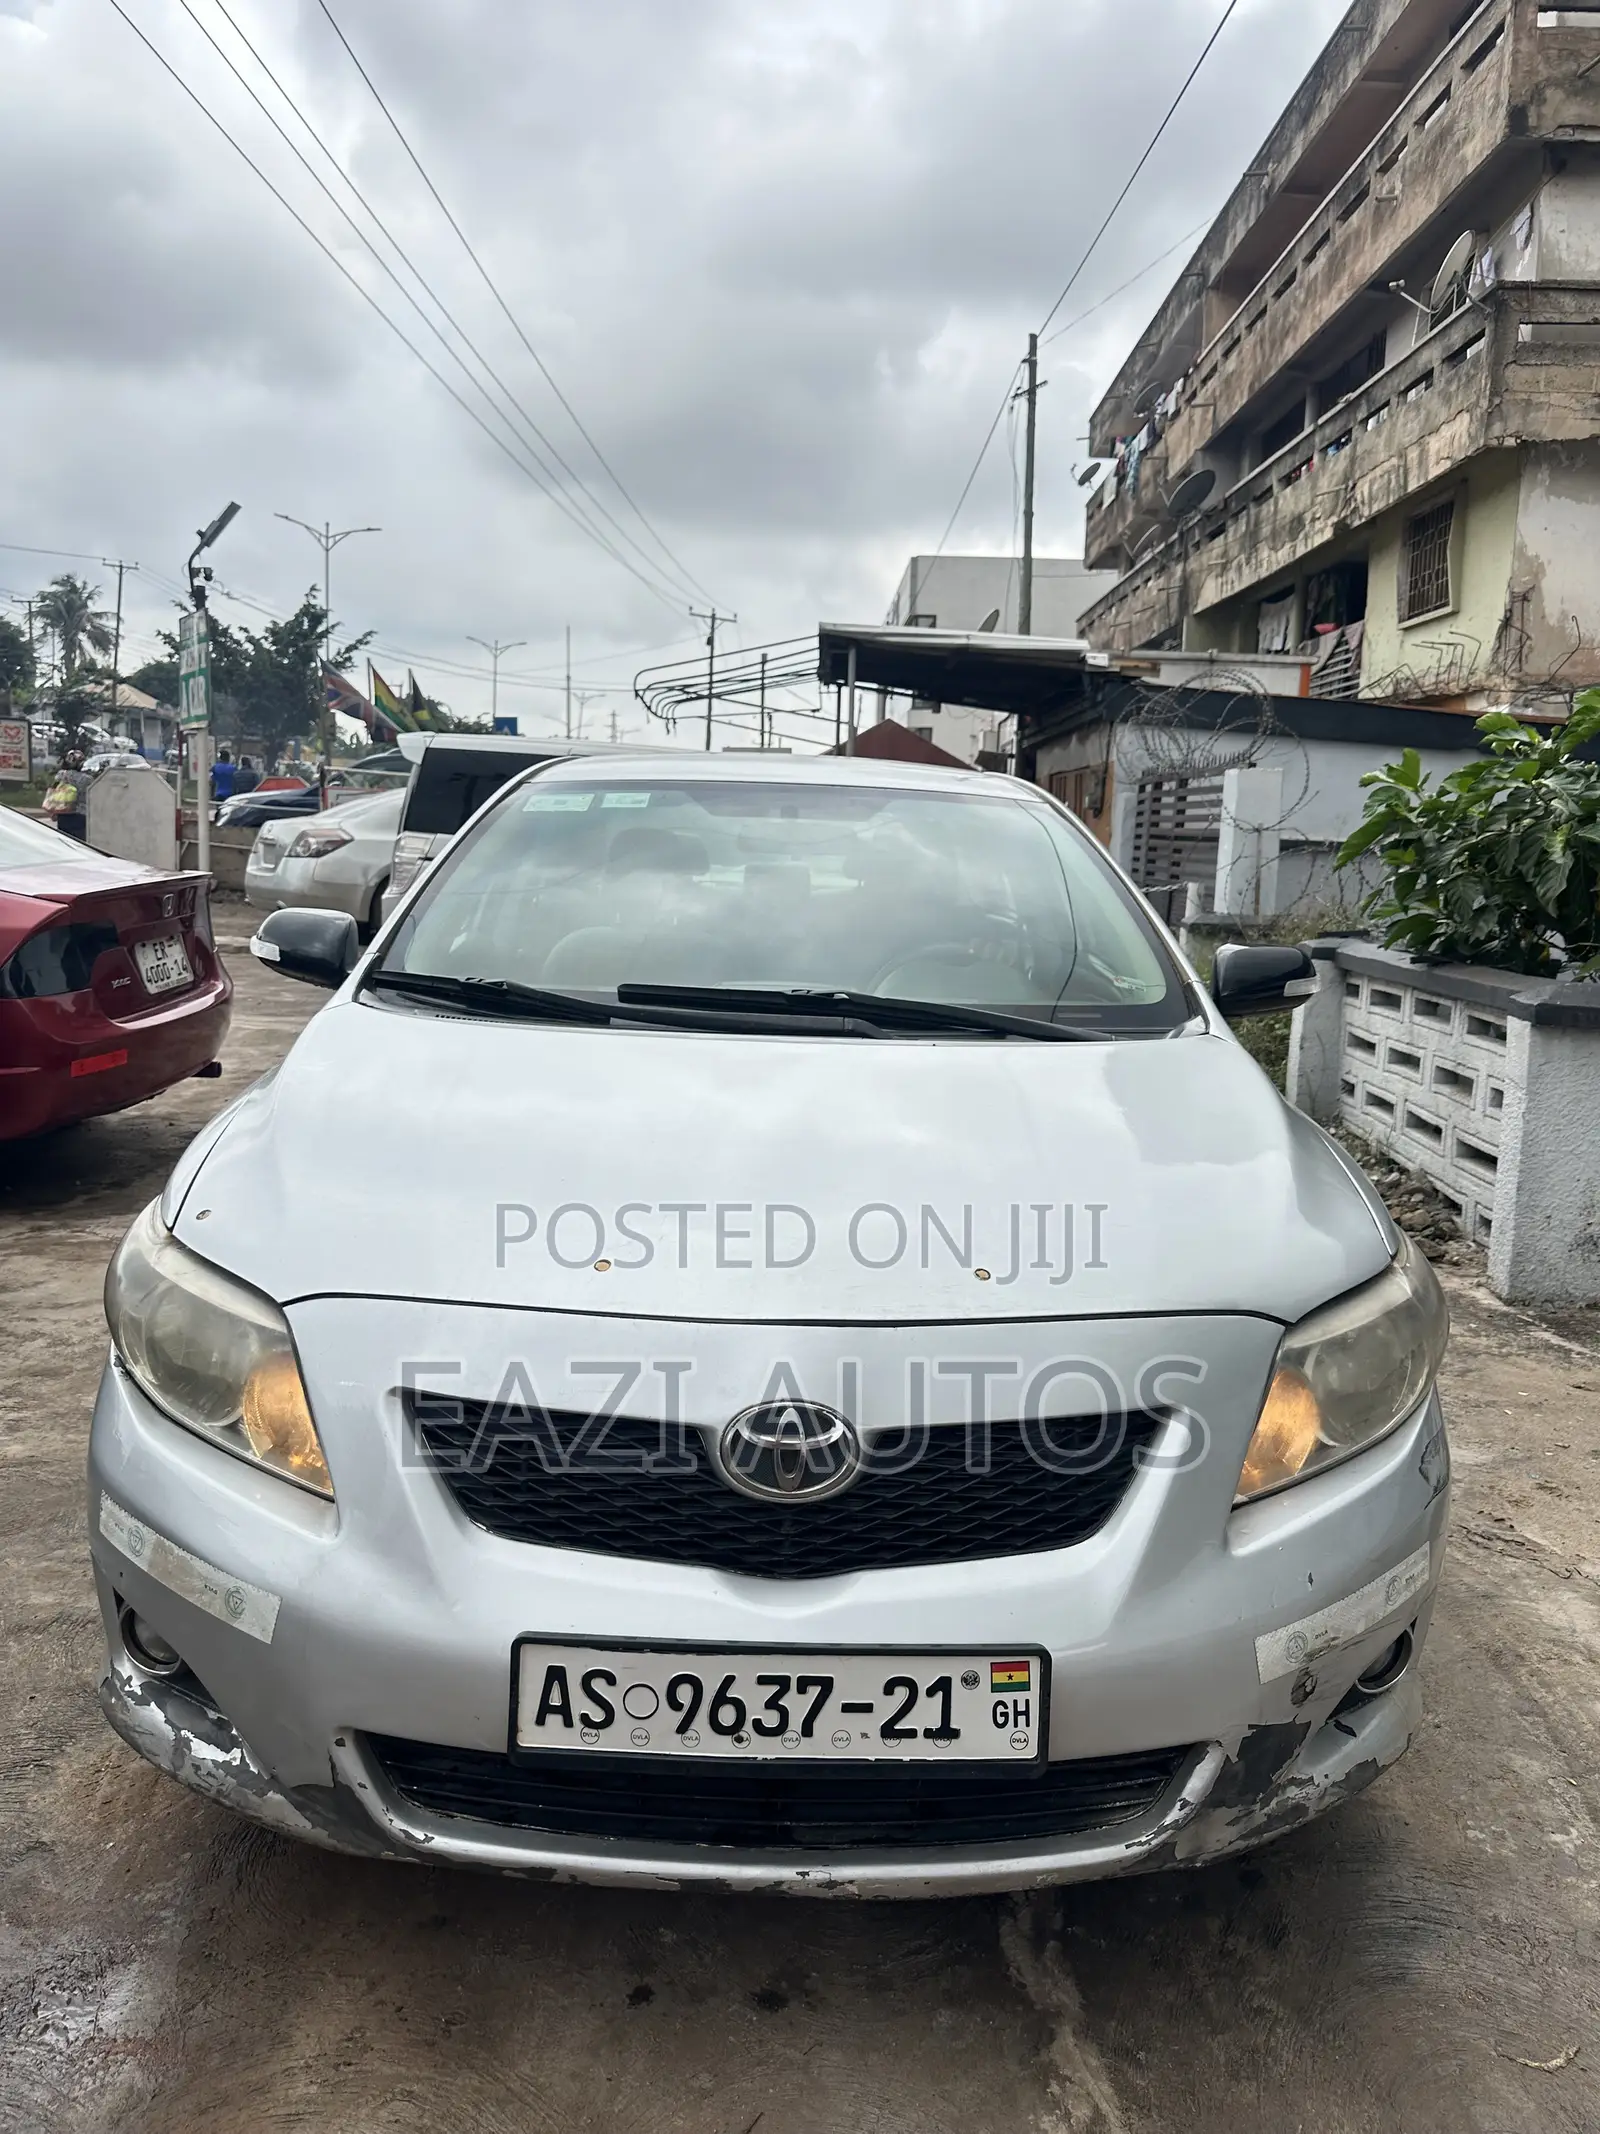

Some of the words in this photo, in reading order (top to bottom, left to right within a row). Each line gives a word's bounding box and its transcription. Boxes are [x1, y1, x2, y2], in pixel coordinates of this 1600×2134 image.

[152, 941, 169, 961] ER
[145, 957, 189, 986] 4000-14
[535, 1664, 617, 1729] AS
[667, 1673, 961, 1738] 9637-21
[992, 1699, 1031, 1729] GH
